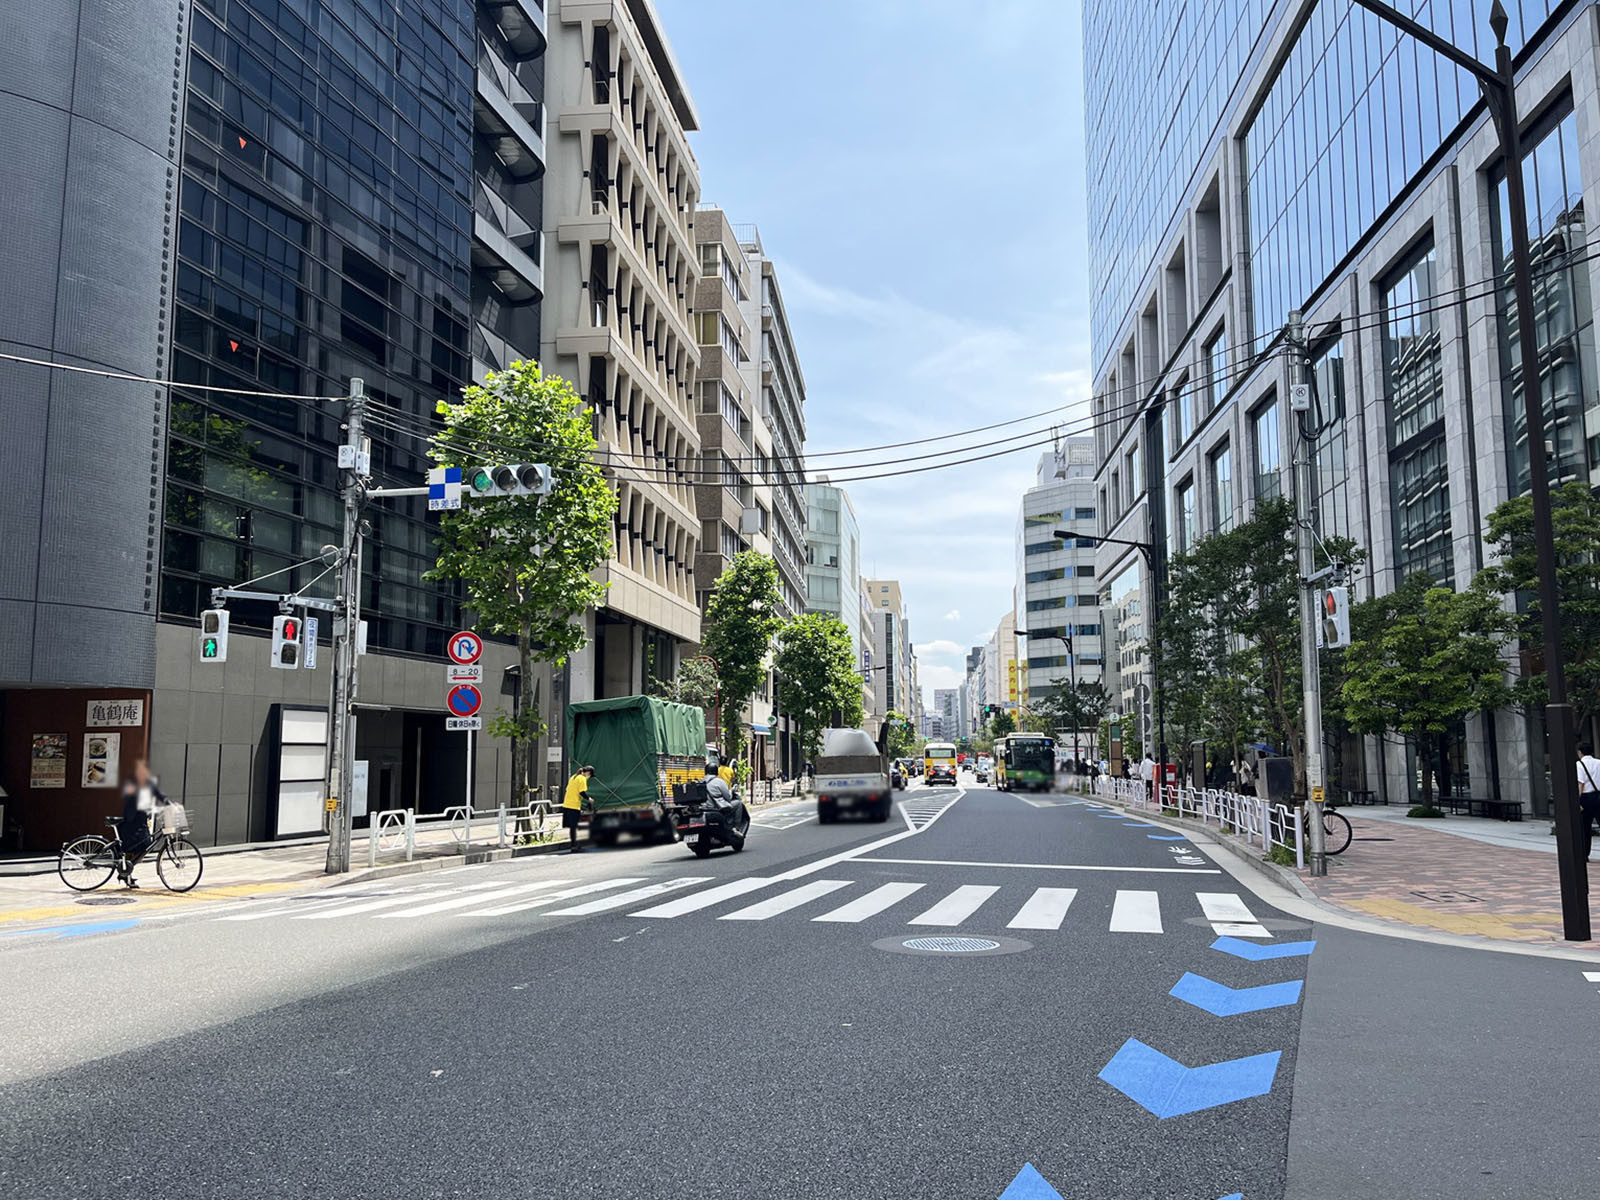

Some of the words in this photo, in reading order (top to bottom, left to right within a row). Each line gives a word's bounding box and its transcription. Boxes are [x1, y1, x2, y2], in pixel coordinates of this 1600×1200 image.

[430, 498, 460, 509] 時差式
[92, 704, 138, 720] 亀鶴庵
